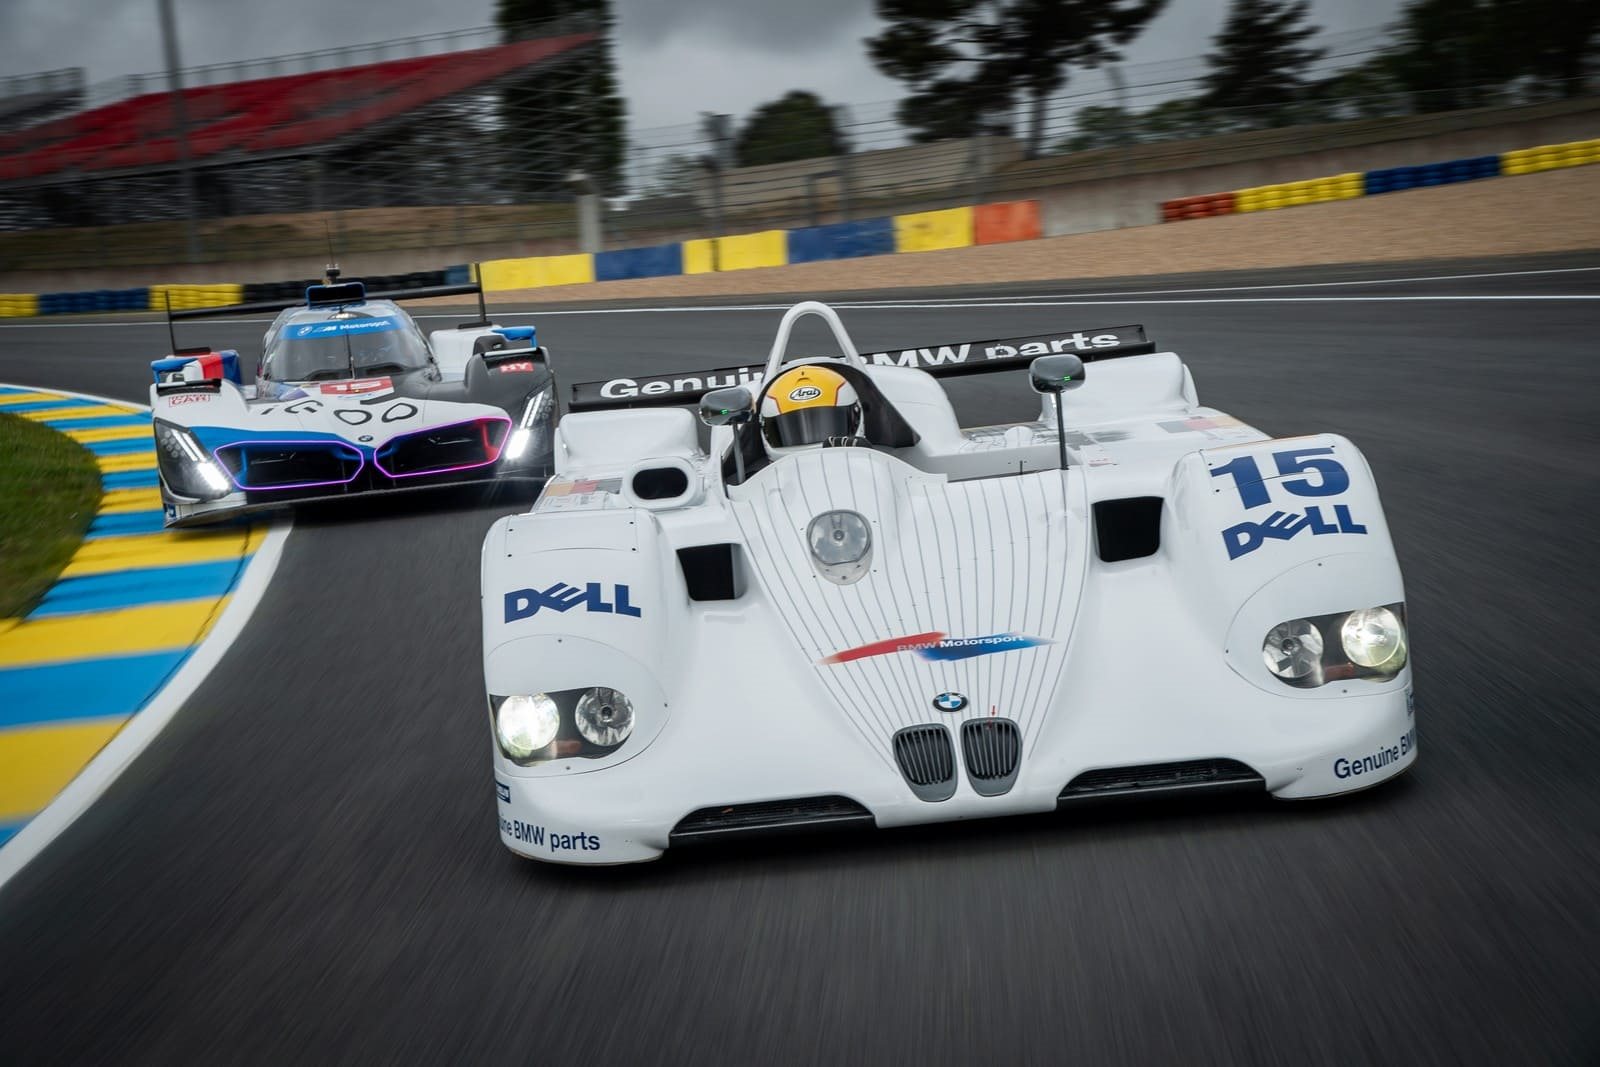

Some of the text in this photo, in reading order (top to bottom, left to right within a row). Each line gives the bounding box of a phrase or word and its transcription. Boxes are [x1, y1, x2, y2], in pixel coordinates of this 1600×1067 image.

[985, 332, 1121, 360] parts
[796, 388, 817, 398] Arai
[1210, 447, 1350, 510] 15
[1221, 504, 1368, 561] DELL
[504, 582, 642, 624] DELL
[896, 635, 1023, 651] BMW Motorsport
[1333, 746, 1399, 779] Genuine
[514, 820, 545, 846] BMW
[550, 831, 600, 853] parts
